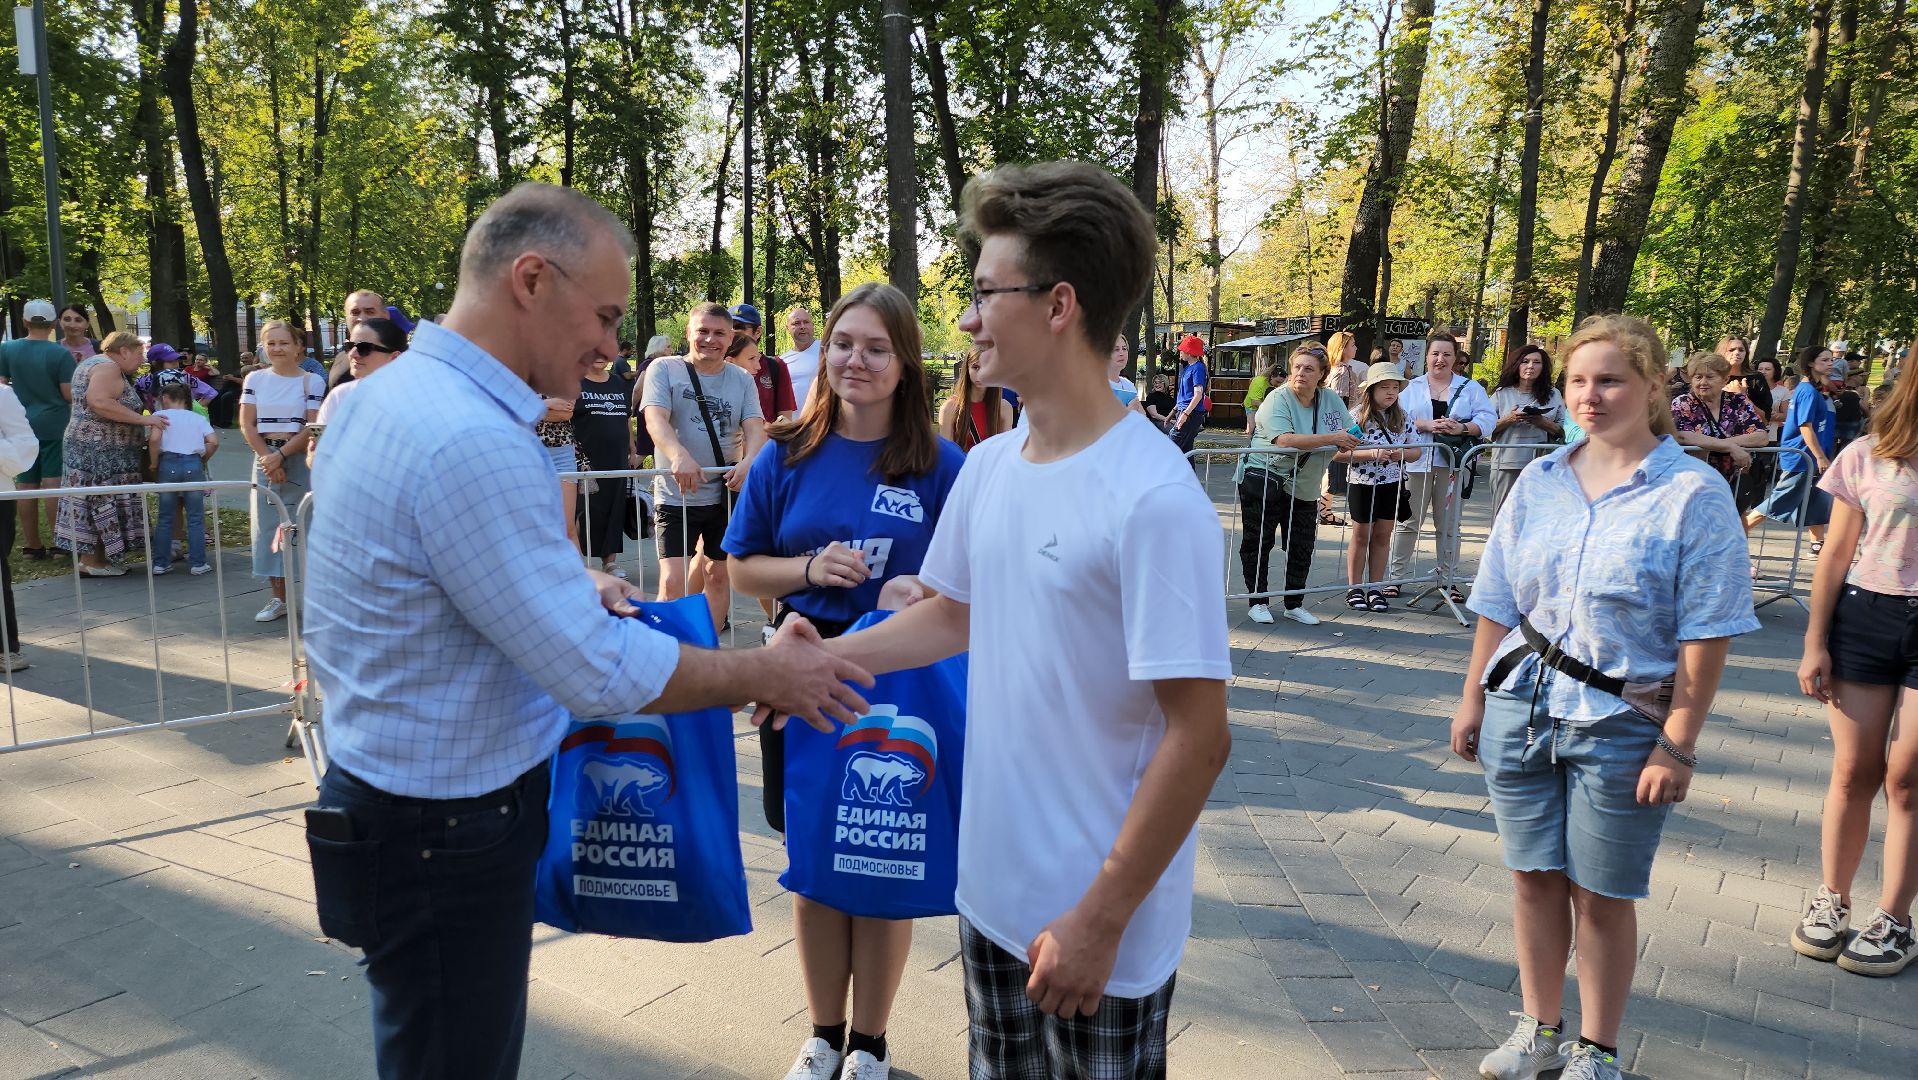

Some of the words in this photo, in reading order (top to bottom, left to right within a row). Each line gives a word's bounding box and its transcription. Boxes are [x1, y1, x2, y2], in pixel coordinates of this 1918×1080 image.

[837, 804, 927, 830] ЕДИНАЯ
[570, 819, 674, 843] ЕДИНАЯ
[834, 825, 926, 851] РОССИЯ
[571, 842, 676, 869] РОССИЯ
[838, 857, 919, 876] ПОДМОСКОВЬЕ
[580, 879, 671, 898] ПОДМОСКОВЬЕ
